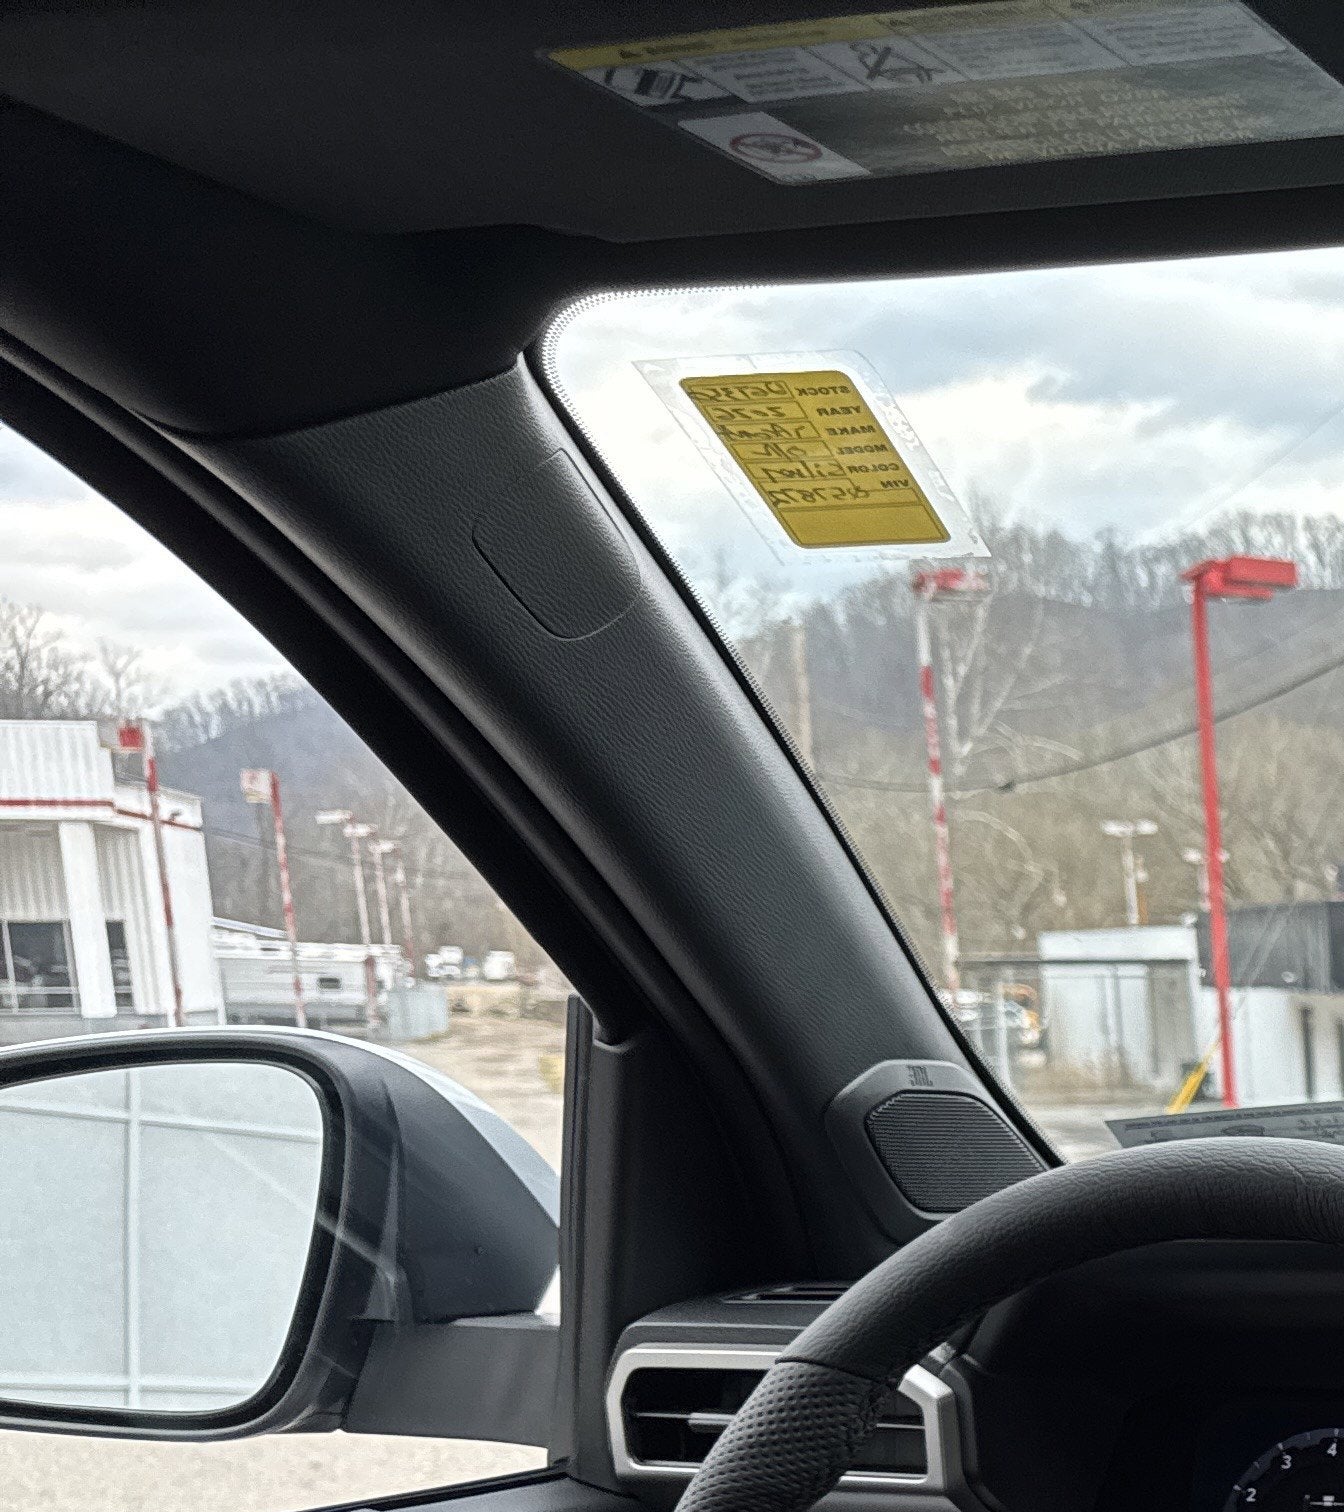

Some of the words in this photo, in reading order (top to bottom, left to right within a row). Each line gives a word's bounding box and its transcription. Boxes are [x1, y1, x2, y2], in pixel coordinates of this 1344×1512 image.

[1326, 1442, 1338, 1457] 4
[1281, 1455, 1292, 1470] 3
[1246, 1488, 1257, 1502] 2
